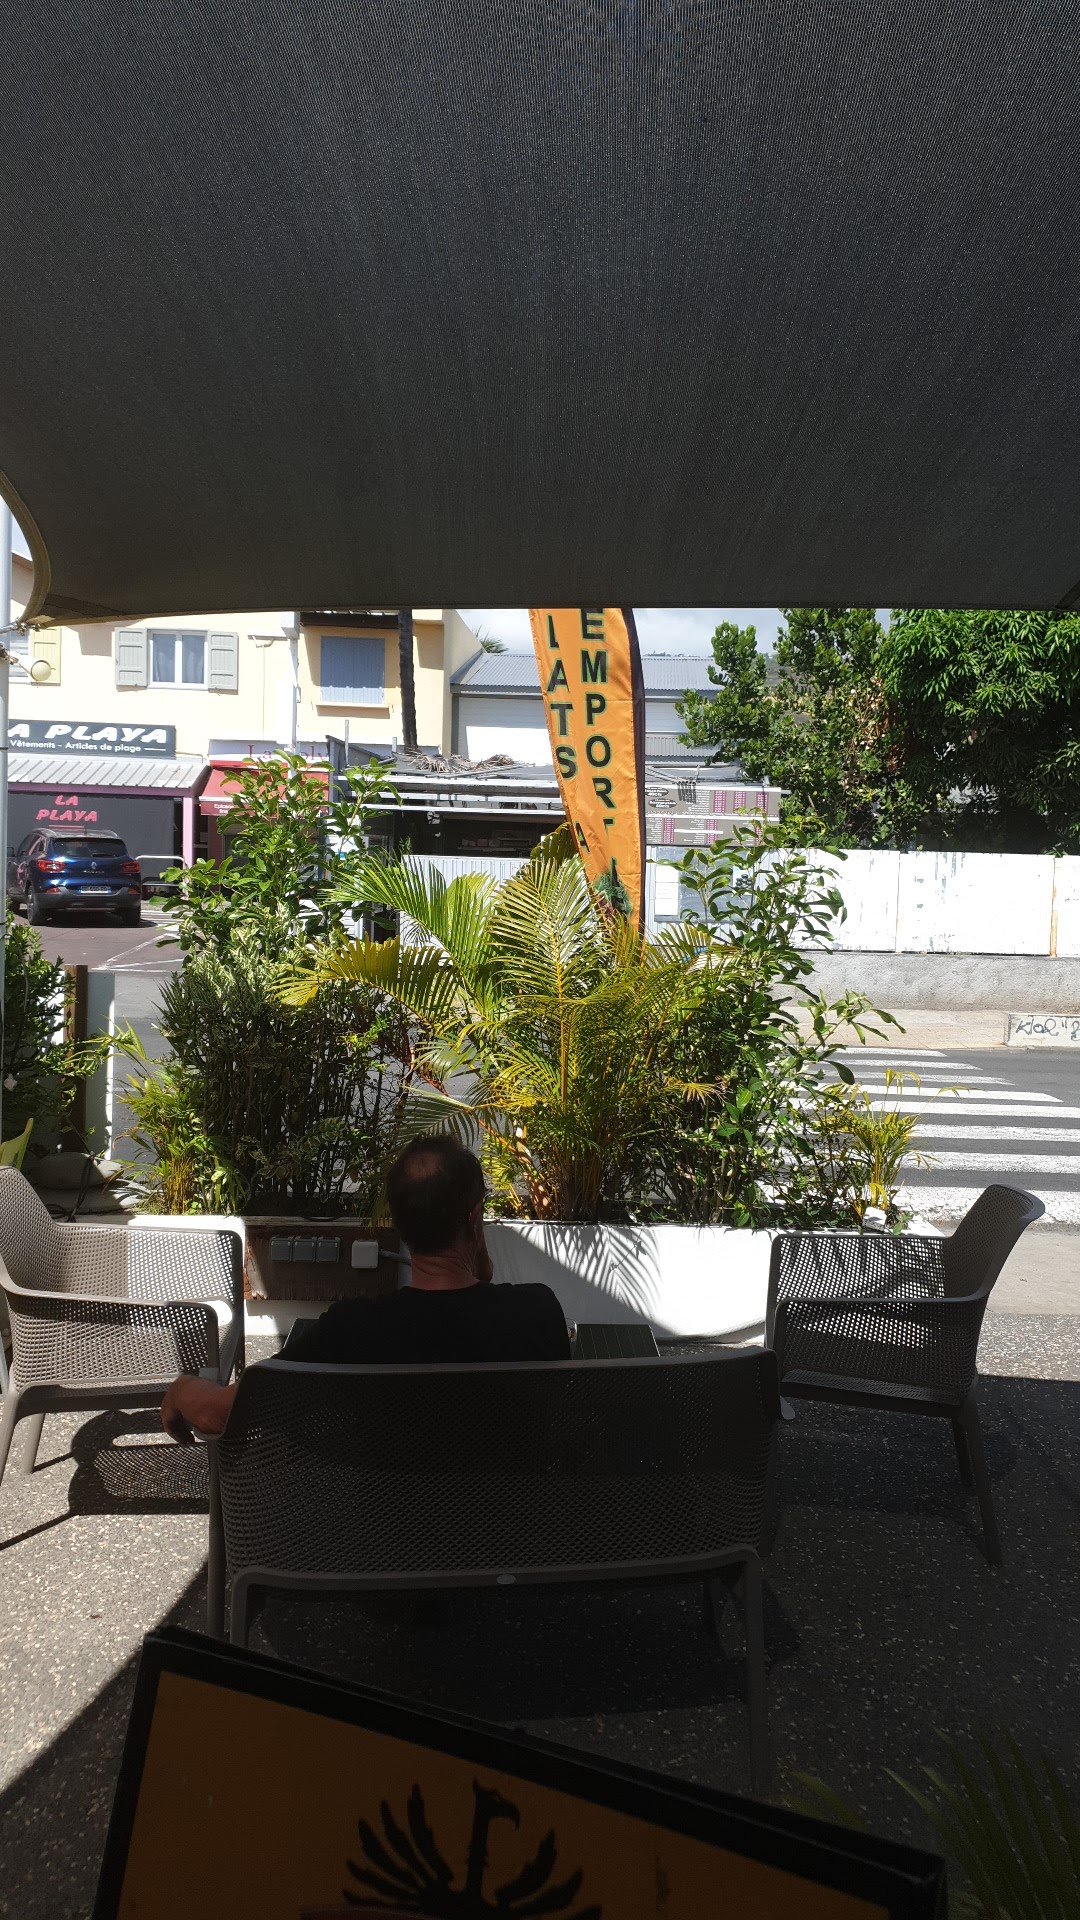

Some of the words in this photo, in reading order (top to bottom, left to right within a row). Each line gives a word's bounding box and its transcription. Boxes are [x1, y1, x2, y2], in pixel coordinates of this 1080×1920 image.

[44, 724, 167, 744] PLAYA
[10, 740, 56, 749] Vêtements
[65, 742, 98, 751] Articles
[99, 743, 112, 751] de
[114, 744, 141, 753] plage
[55, 795, 79, 806] LA
[36, 809, 98, 822] PLAYA
